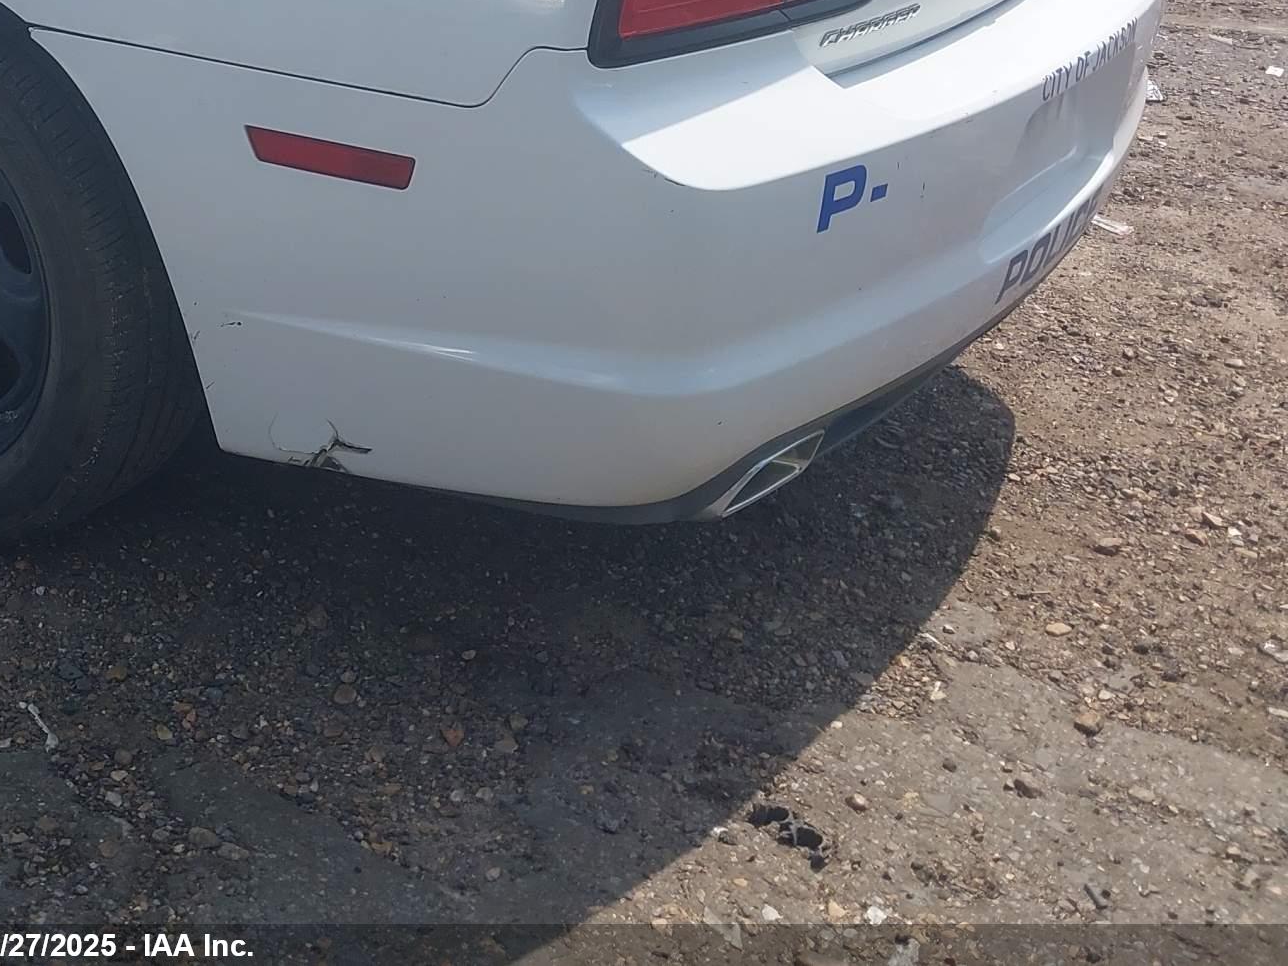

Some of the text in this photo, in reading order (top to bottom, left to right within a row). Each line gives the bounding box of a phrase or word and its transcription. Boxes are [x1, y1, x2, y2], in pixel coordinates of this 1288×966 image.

[1042, 16, 1138, 102] CITY OF JACKSON
[816, 164, 888, 234] P-
[993, 194, 1102, 305] POLICE
